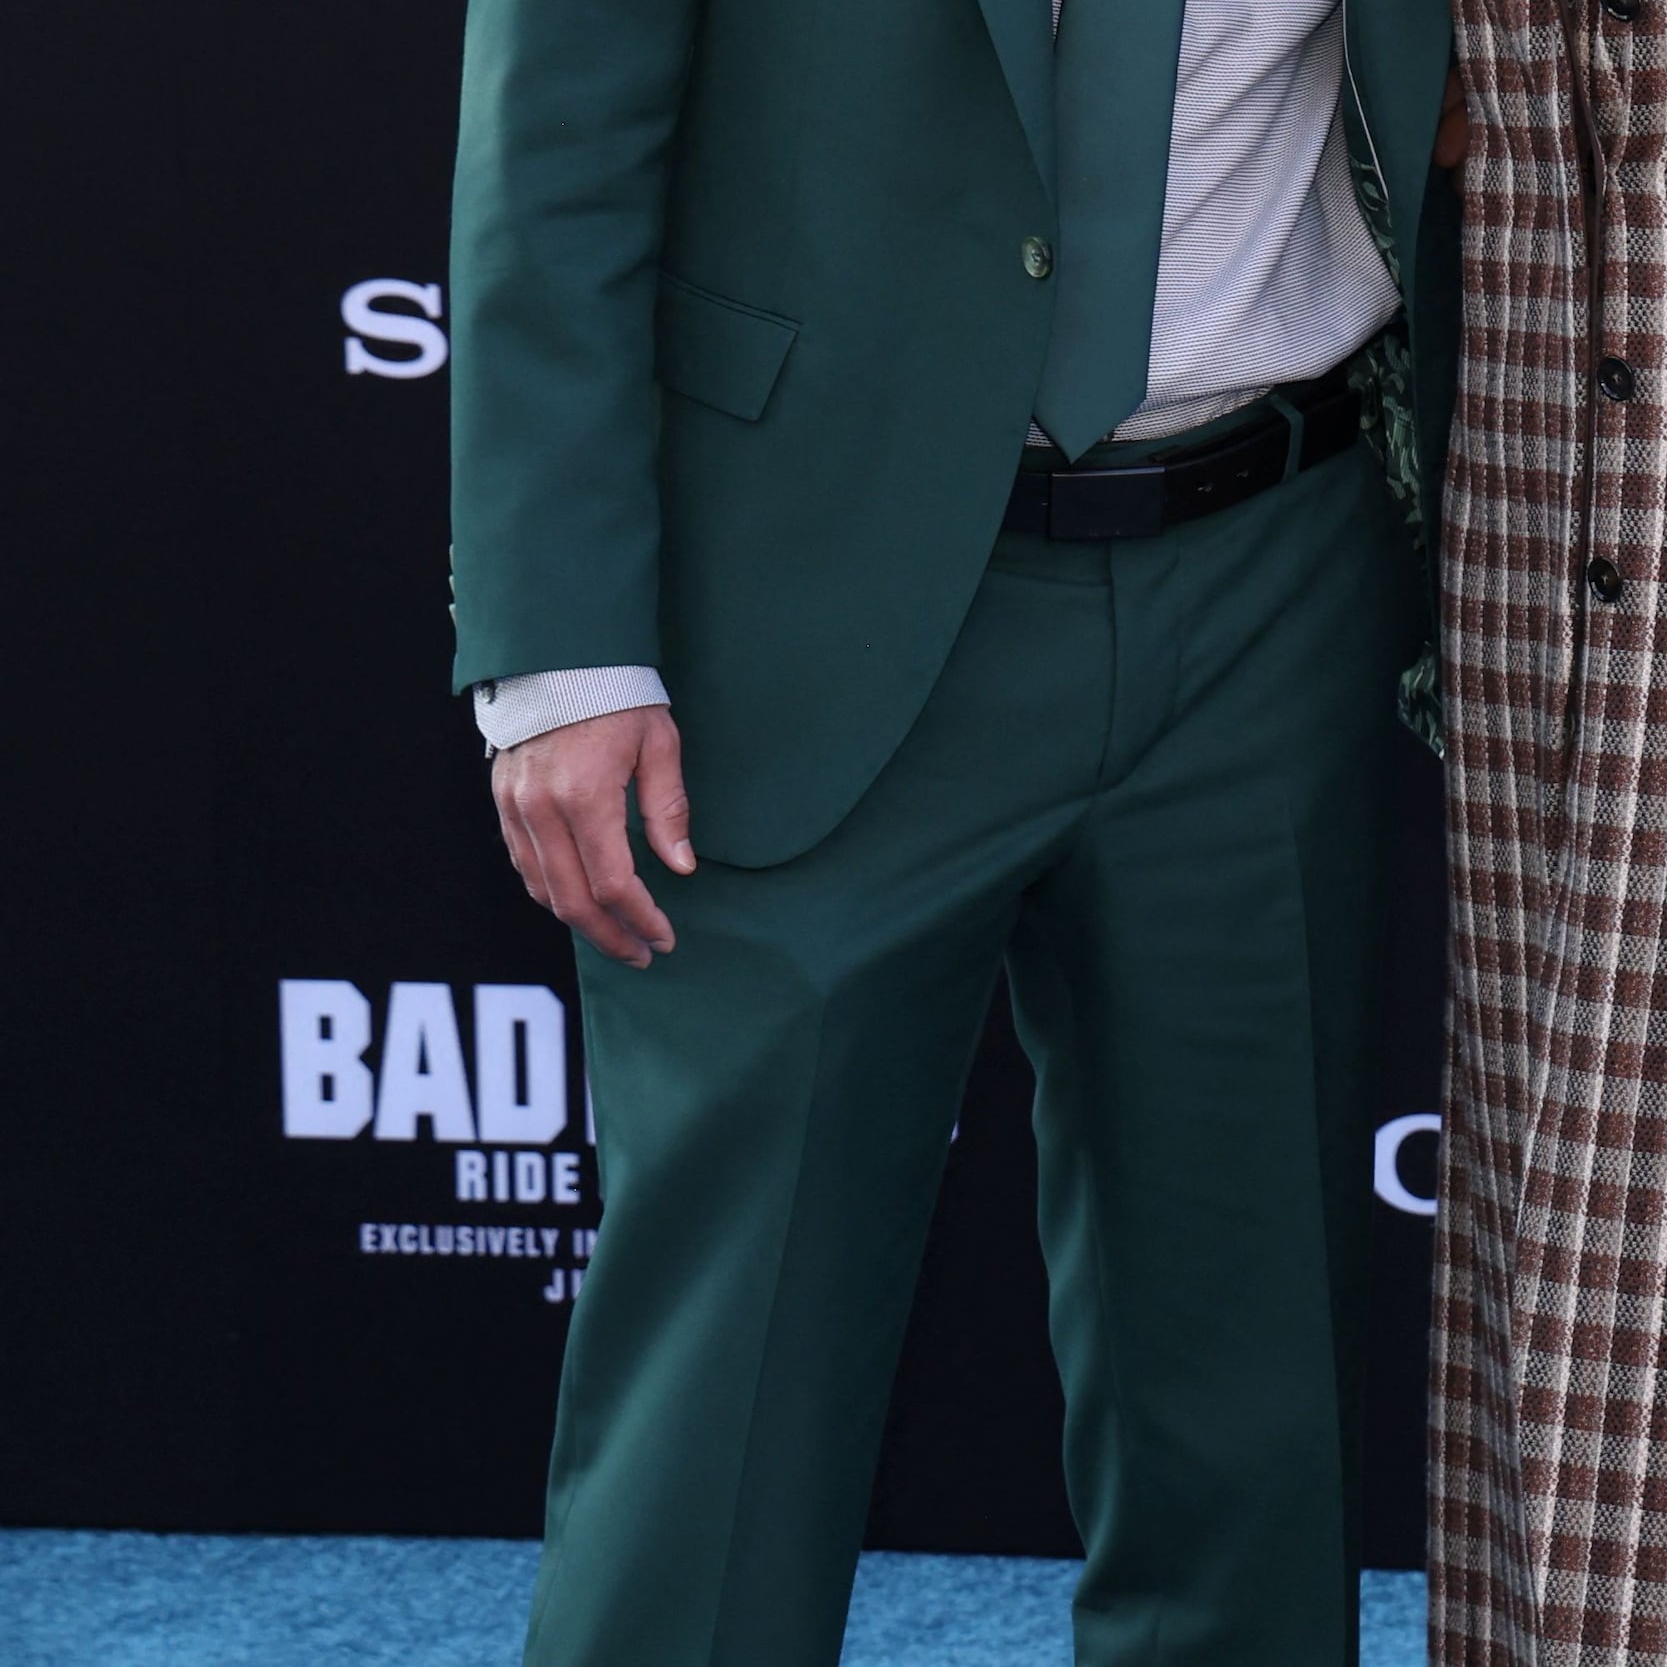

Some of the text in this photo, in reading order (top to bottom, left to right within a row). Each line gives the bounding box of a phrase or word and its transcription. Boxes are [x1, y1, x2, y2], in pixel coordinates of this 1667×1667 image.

[280, 979, 567, 1143] BAD
[456, 1150, 580, 1204] RIDE
[360, 1224, 559, 1257] EXCLUSIVELY
